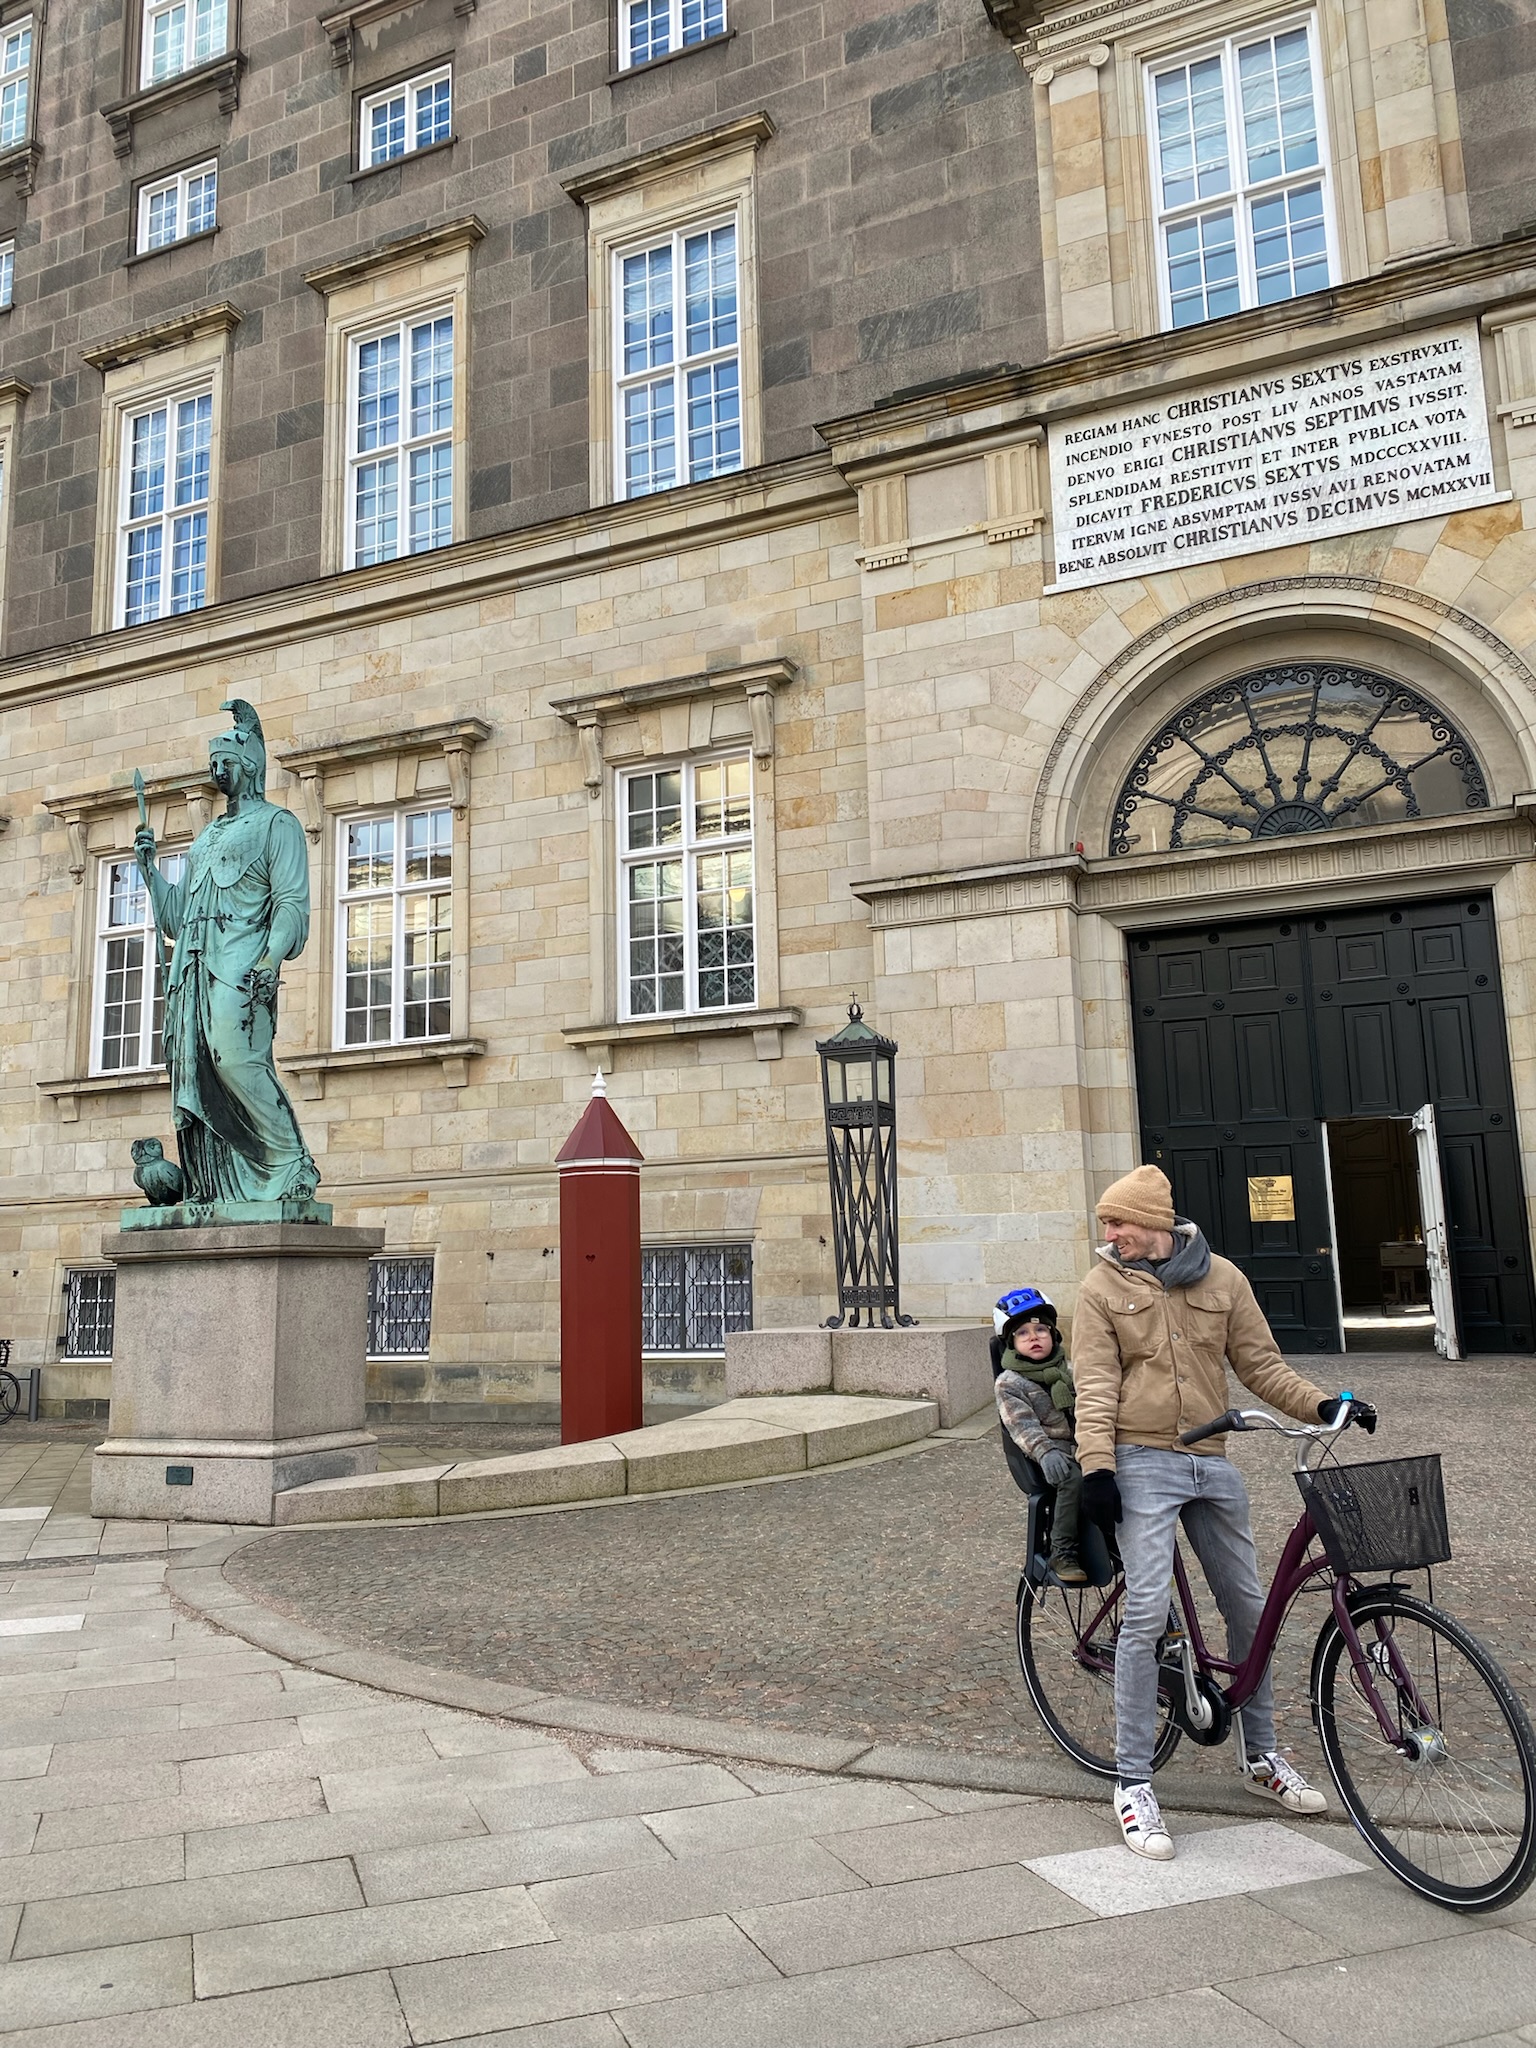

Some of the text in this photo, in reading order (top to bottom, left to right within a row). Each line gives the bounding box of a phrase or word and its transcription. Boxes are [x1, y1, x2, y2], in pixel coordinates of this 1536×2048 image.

[1065, 339, 1463, 445] REGIAM HANC CHRISTIANVS SEXTVS EXSTRVXIT.
[1066, 361, 1462, 466] INCENDIO FVNESTO POST LIV ANNOS VASTATAM
[1068, 384, 1467, 487] DENVO ERIGI CHRISTIANVS SEPTIMVS IVSSIT.
[1069, 408, 1467, 508] SPLENDIDAM RESTITVIT ET INTER PVBLICA VOTA
[1072, 453, 1471, 550] ITERVM IGNE ABSVMPTAM IVSSV AVI RENOVATAM
[1076, 432, 1467, 527] DICAVIT FREDERICVS SEXTVS MDCCCXXVIII.
[1059, 472, 1491, 574] BENE ABSOLVIT CHRISTIANVS DECIMVS MCMXXVII
[1156, 1150, 1162, 1159] 5
